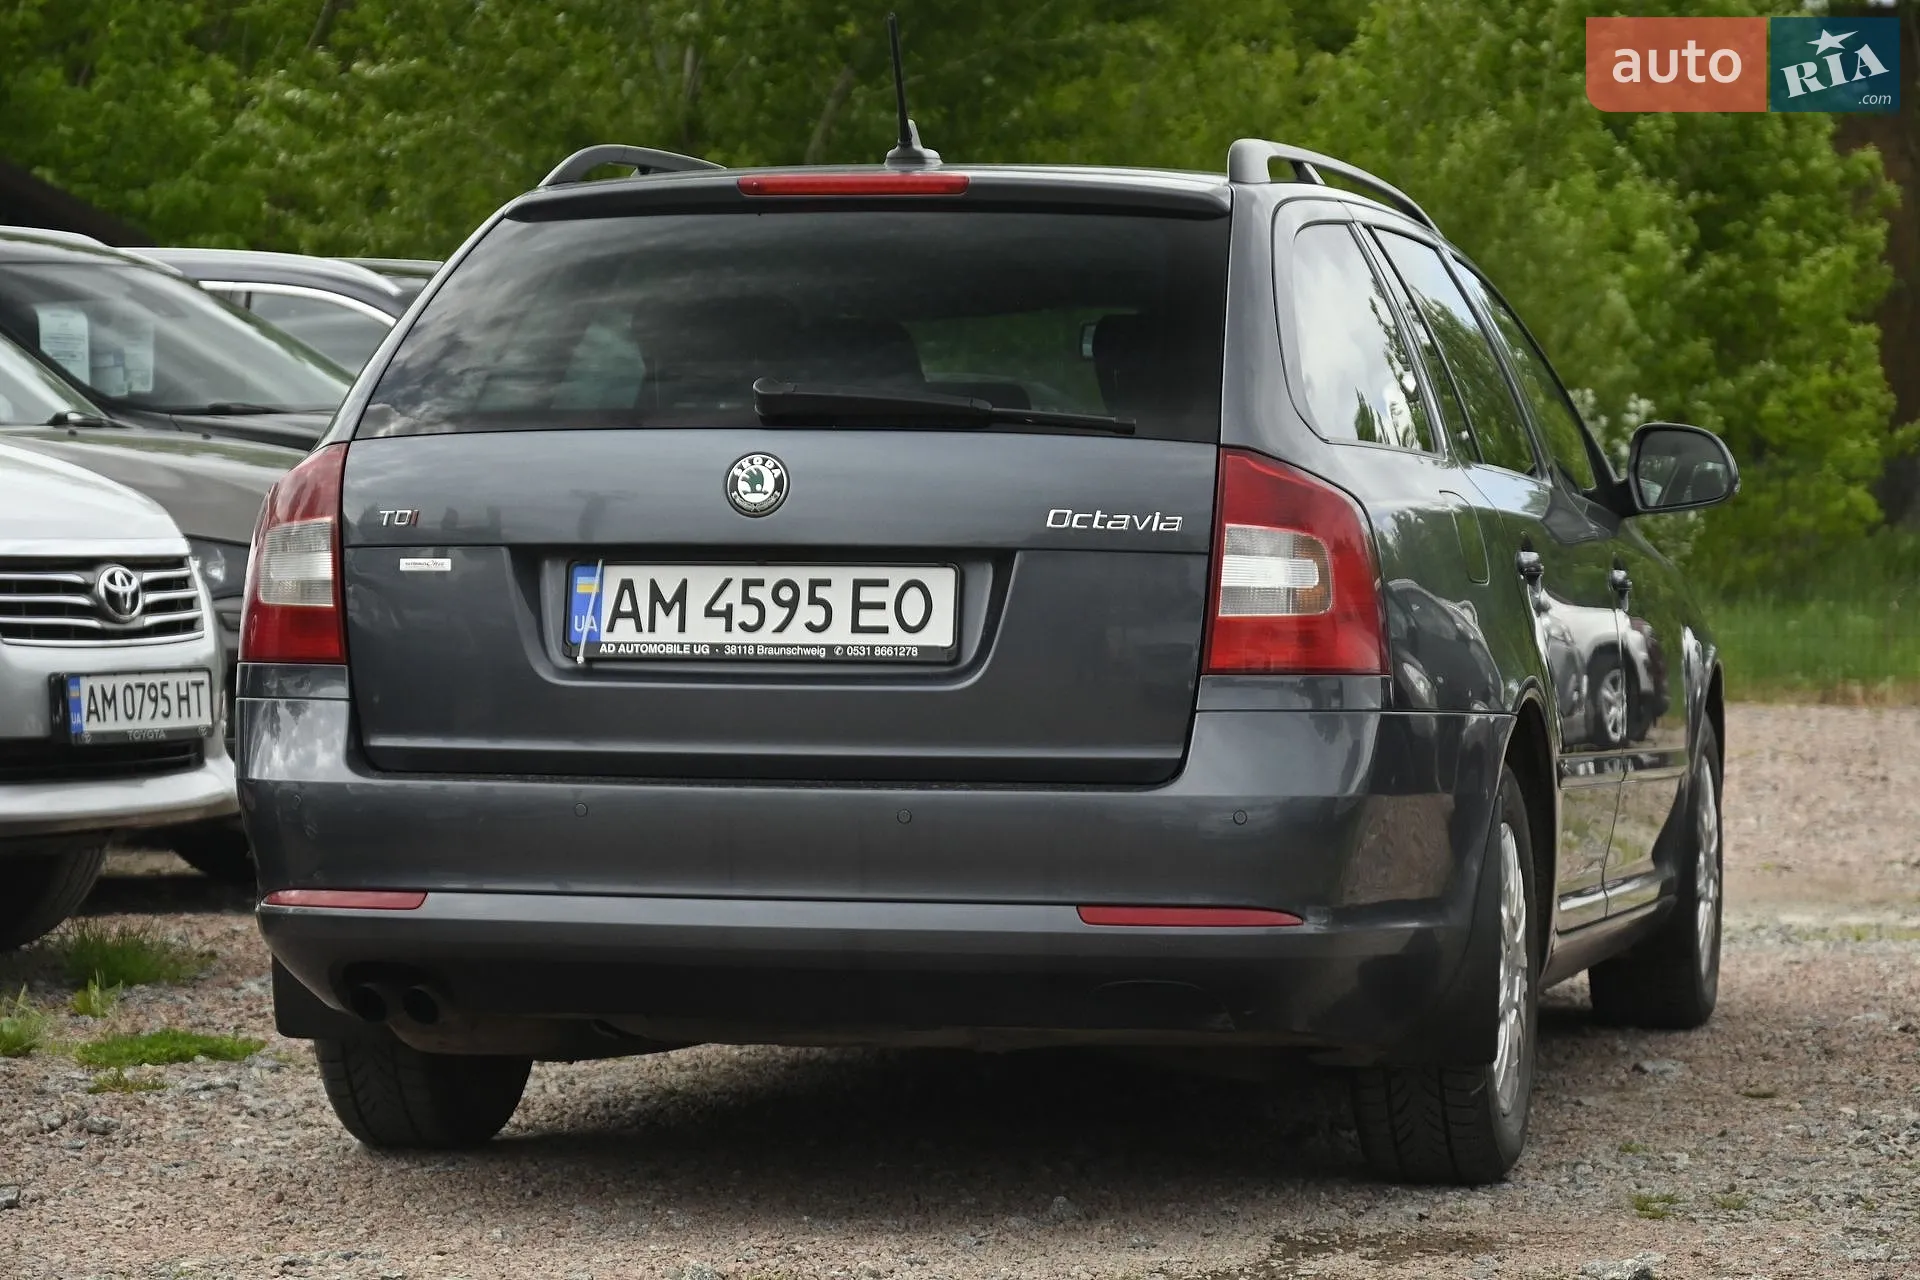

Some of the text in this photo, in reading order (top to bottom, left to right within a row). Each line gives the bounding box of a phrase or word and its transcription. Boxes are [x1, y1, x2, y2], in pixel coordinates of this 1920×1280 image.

[1046, 509, 1183, 532] Octavia
[606, 578, 933, 634] AM 4595 EO
[574, 615, 598, 632] UA
[600, 643, 918, 658] AD AUTOMOBILE UG 38118 Braunschweig 0531 8661278
[86, 680, 205, 723] AM 0795 HT
[71, 713, 81, 724] UA
[127, 728, 166, 741] TOYOTA
